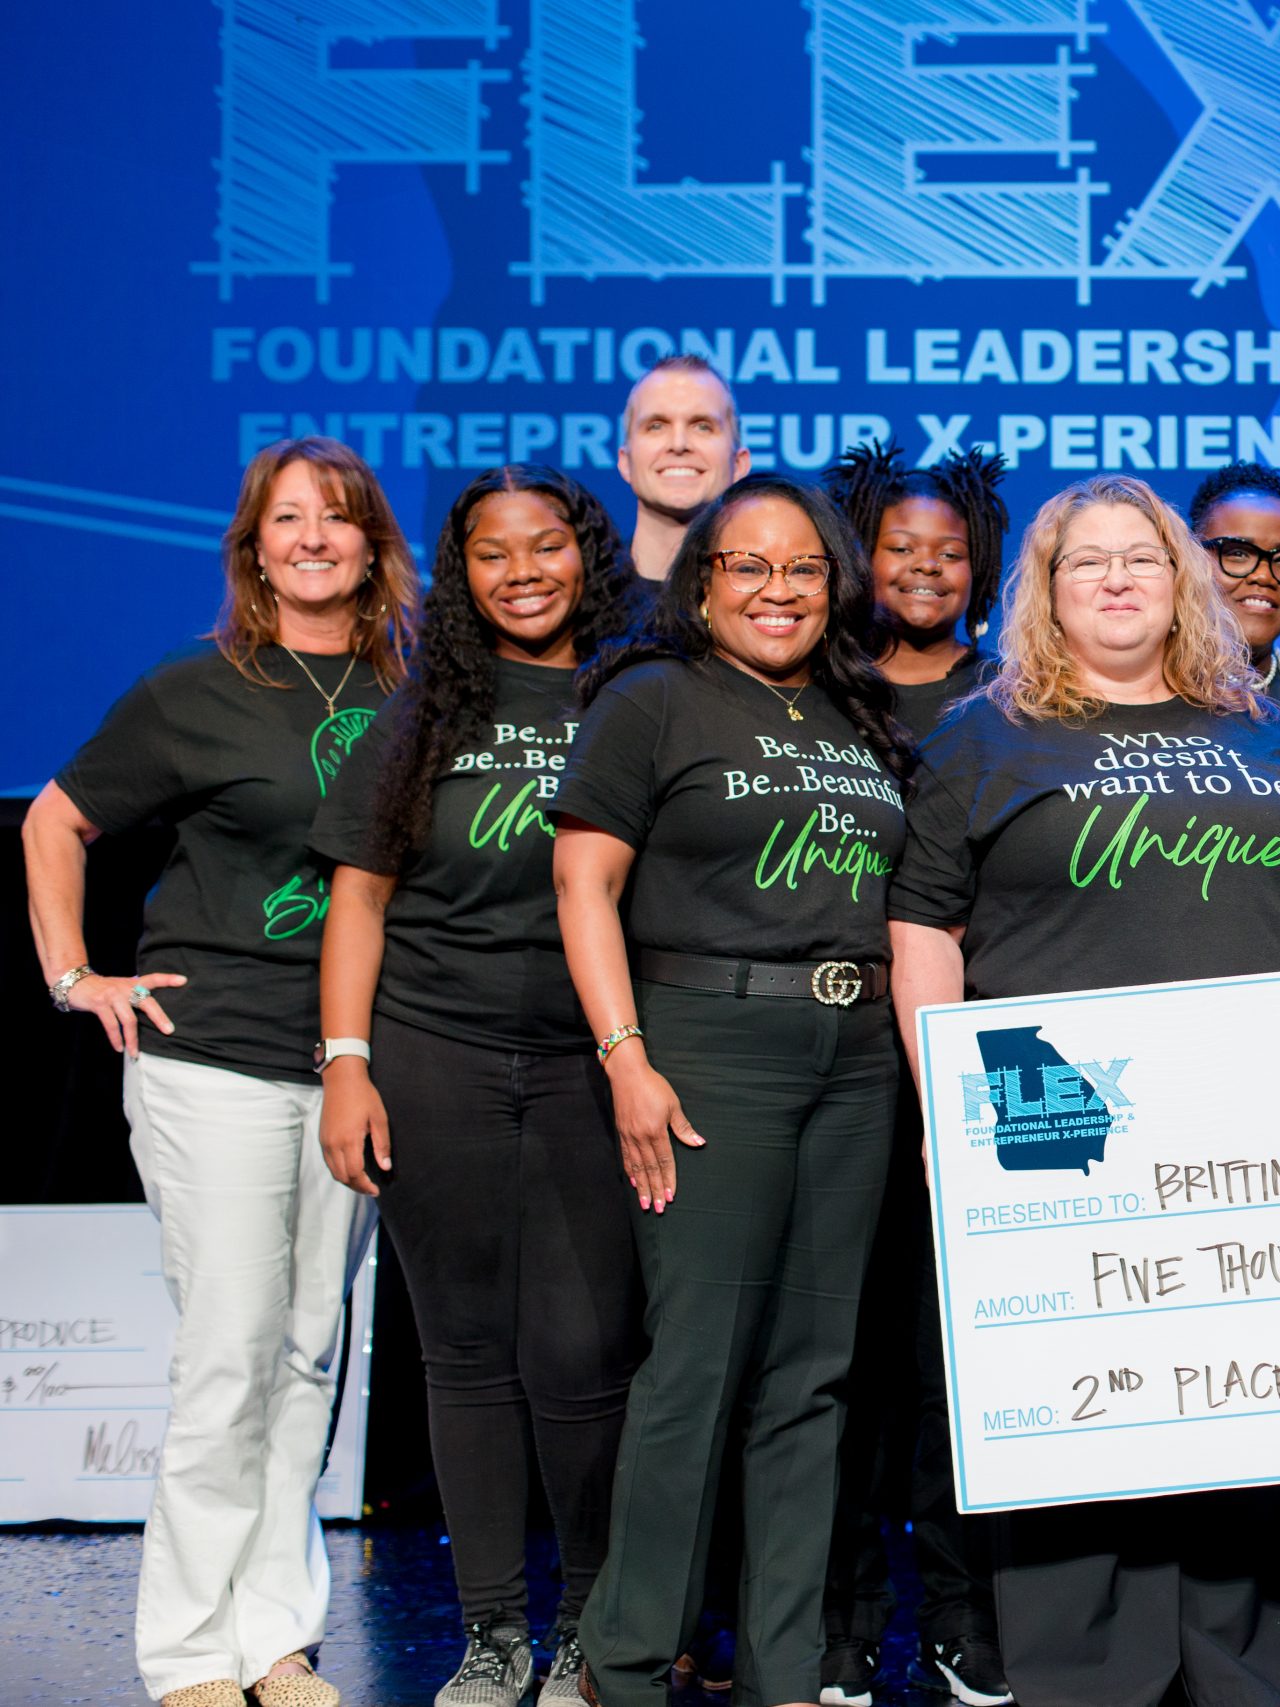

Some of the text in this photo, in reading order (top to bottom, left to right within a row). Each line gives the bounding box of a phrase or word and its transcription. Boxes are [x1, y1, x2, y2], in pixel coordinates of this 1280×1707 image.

[211, 327, 839, 384] FOUNDATIONAL
[237, 413, 892, 470] ENTREPREUR
[755, 736, 881, 772] Be...Bold
[1093, 748, 1249, 771] doesn't
[1100, 732, 1224, 751] Who,
[724, 765, 904, 812] Be...Beautifu
[1062, 771, 1174, 802] want
[1185, 770, 1232, 795] to
[818, 803, 878, 838] Be...
[755, 810, 893, 903] Unique
[958, 1056, 1136, 1124] FLEX
[965, 1113, 1136, 1136] FOUNDATIONAL LEADERSHIP &
[970, 1125, 1129, 1148] ENTREPRENEUR X-PERIENCE
[967, 1192, 1146, 1228] PRESENTED TO:
[1092, 1251, 1187, 1308] FIVE
[974, 1291, 1075, 1320] AMOUNT:
[1072, 1367, 1143, 1421] 2ND
[984, 1405, 1060, 1430] MEMO:
